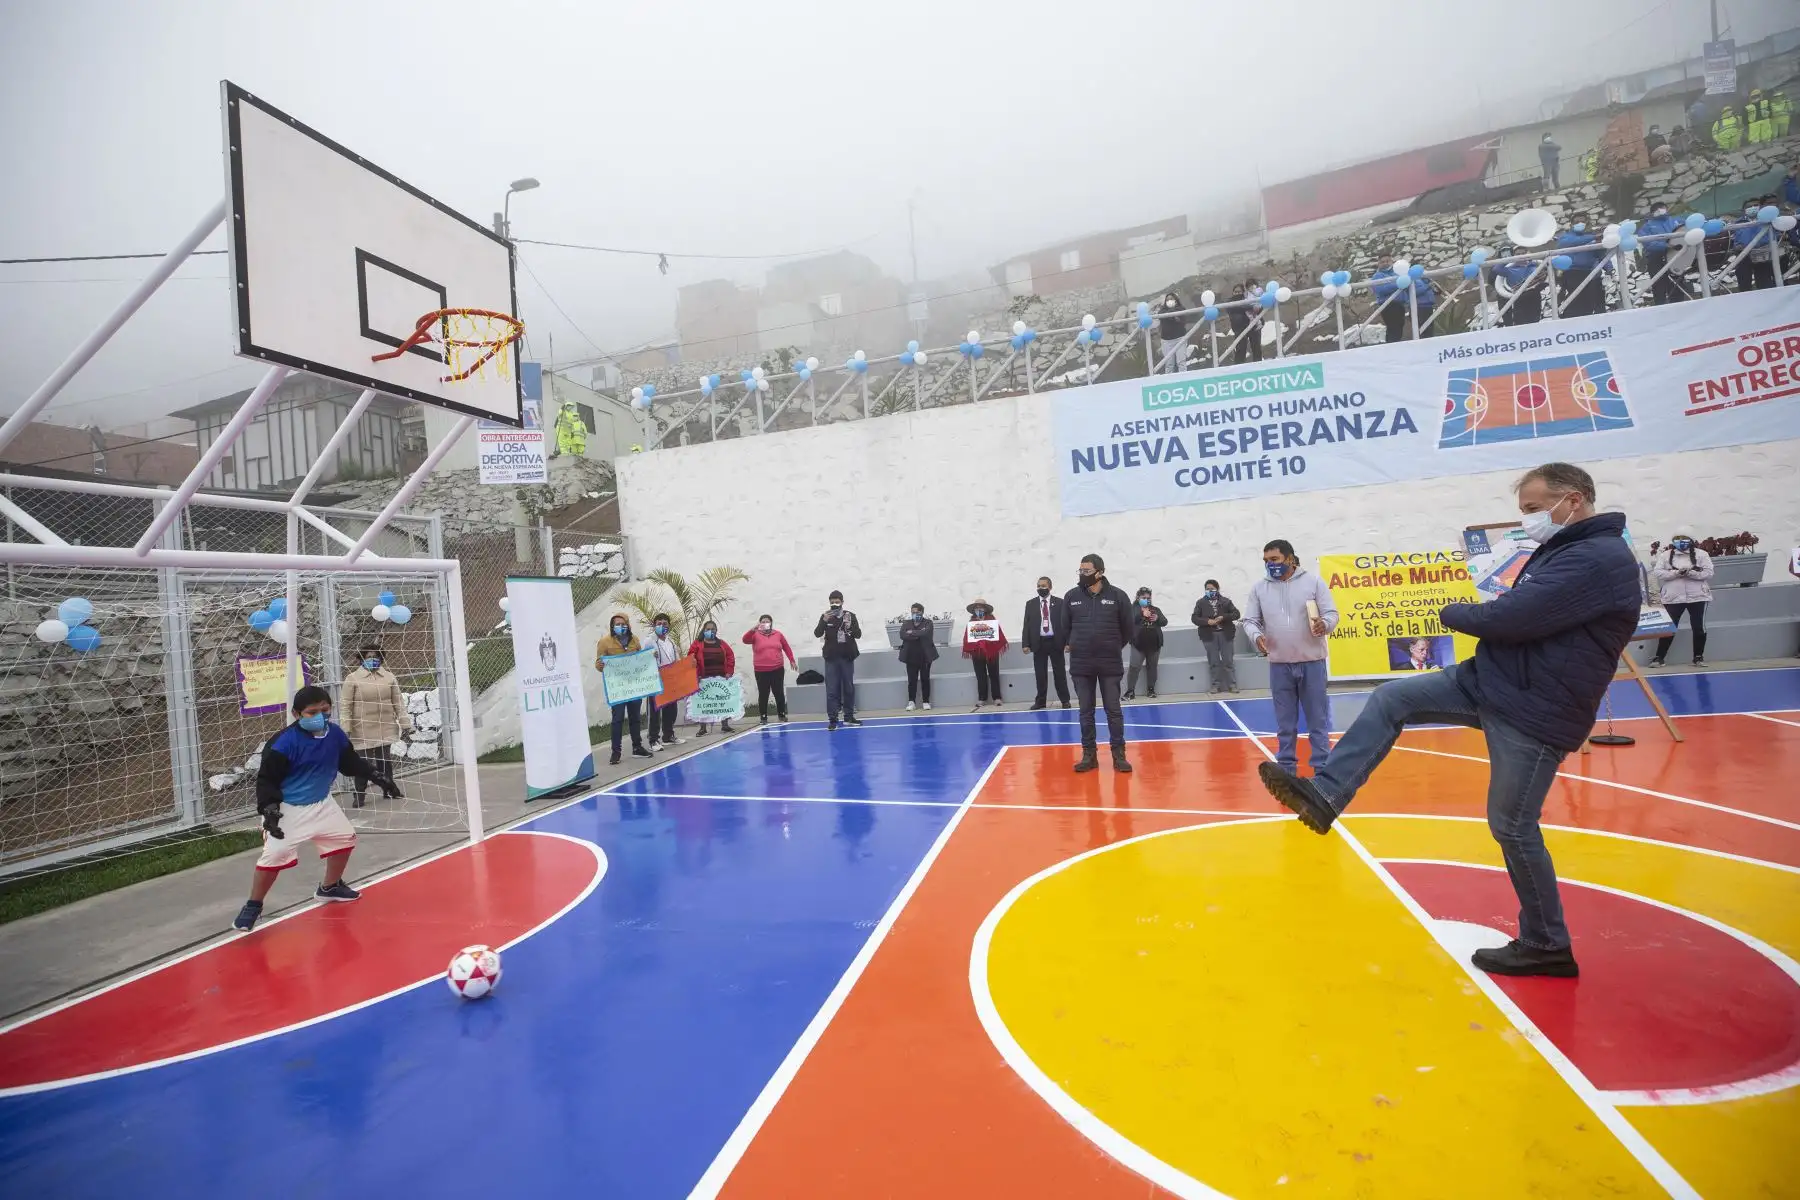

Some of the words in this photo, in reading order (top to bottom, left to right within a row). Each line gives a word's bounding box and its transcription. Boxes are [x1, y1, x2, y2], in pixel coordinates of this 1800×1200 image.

[1438, 346, 1473, 363] ¡Más
[1475, 342, 1517, 356] obras
[1519, 336, 1553, 353] para
[1555, 326, 1613, 345] Comas!
[1148, 386, 1200, 406] LOSA
[1203, 369, 1317, 399] DEPORTIVA
[1110, 405, 1264, 438] ASENTAMIENTO
[1268, 391, 1366, 418] HUMANO
[497, 443, 528, 452] LOSA
[1071, 436, 1189, 474] NUEVA
[1197, 407, 1419, 459] ESPERANZA
[482, 454, 544, 464] DEPORTIVA
[1174, 454, 1273, 488] COMITÉ
[1277, 455, 1306, 476] 10
[1355, 550, 1465, 570] GRACIAS
[1469, 546, 1490, 554] LIMA
[1329, 569, 1404, 590] Alcalde
[1380, 590, 1398, 600] por
[1402, 586, 1449, 598] nuestra:
[1347, 612, 1356, 621] Y
[1360, 611, 1390, 620] LAS
[1354, 601, 1397, 611] CASA
[1364, 621, 1383, 638] Sr.
[1386, 619, 1404, 637] de
[1408, 618, 1420, 635] la
[524, 685, 574, 712] LIMA
